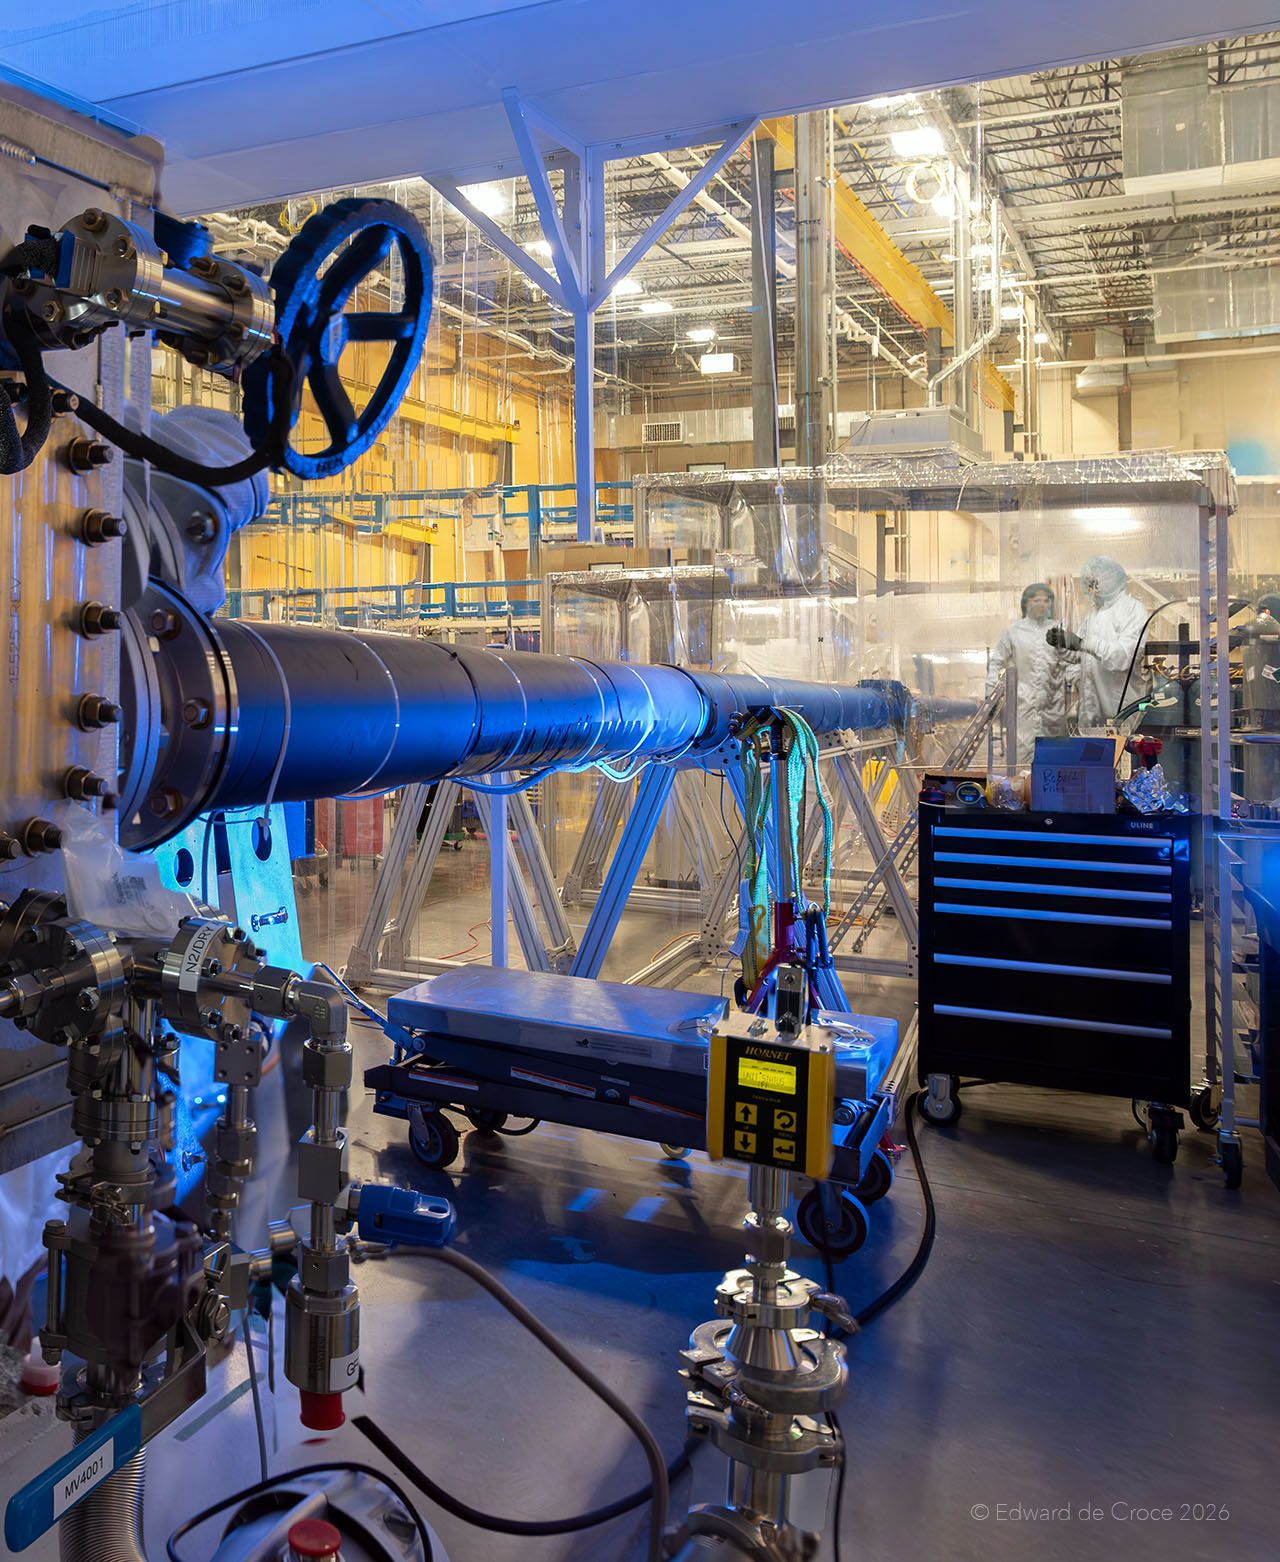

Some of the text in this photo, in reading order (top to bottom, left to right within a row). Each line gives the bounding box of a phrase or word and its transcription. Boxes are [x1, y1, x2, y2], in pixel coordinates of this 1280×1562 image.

[185, 926, 214, 973] N2/DRY
[745, 1045, 791, 1061] HORNET
[64, 1456, 103, 1499] MV4001
